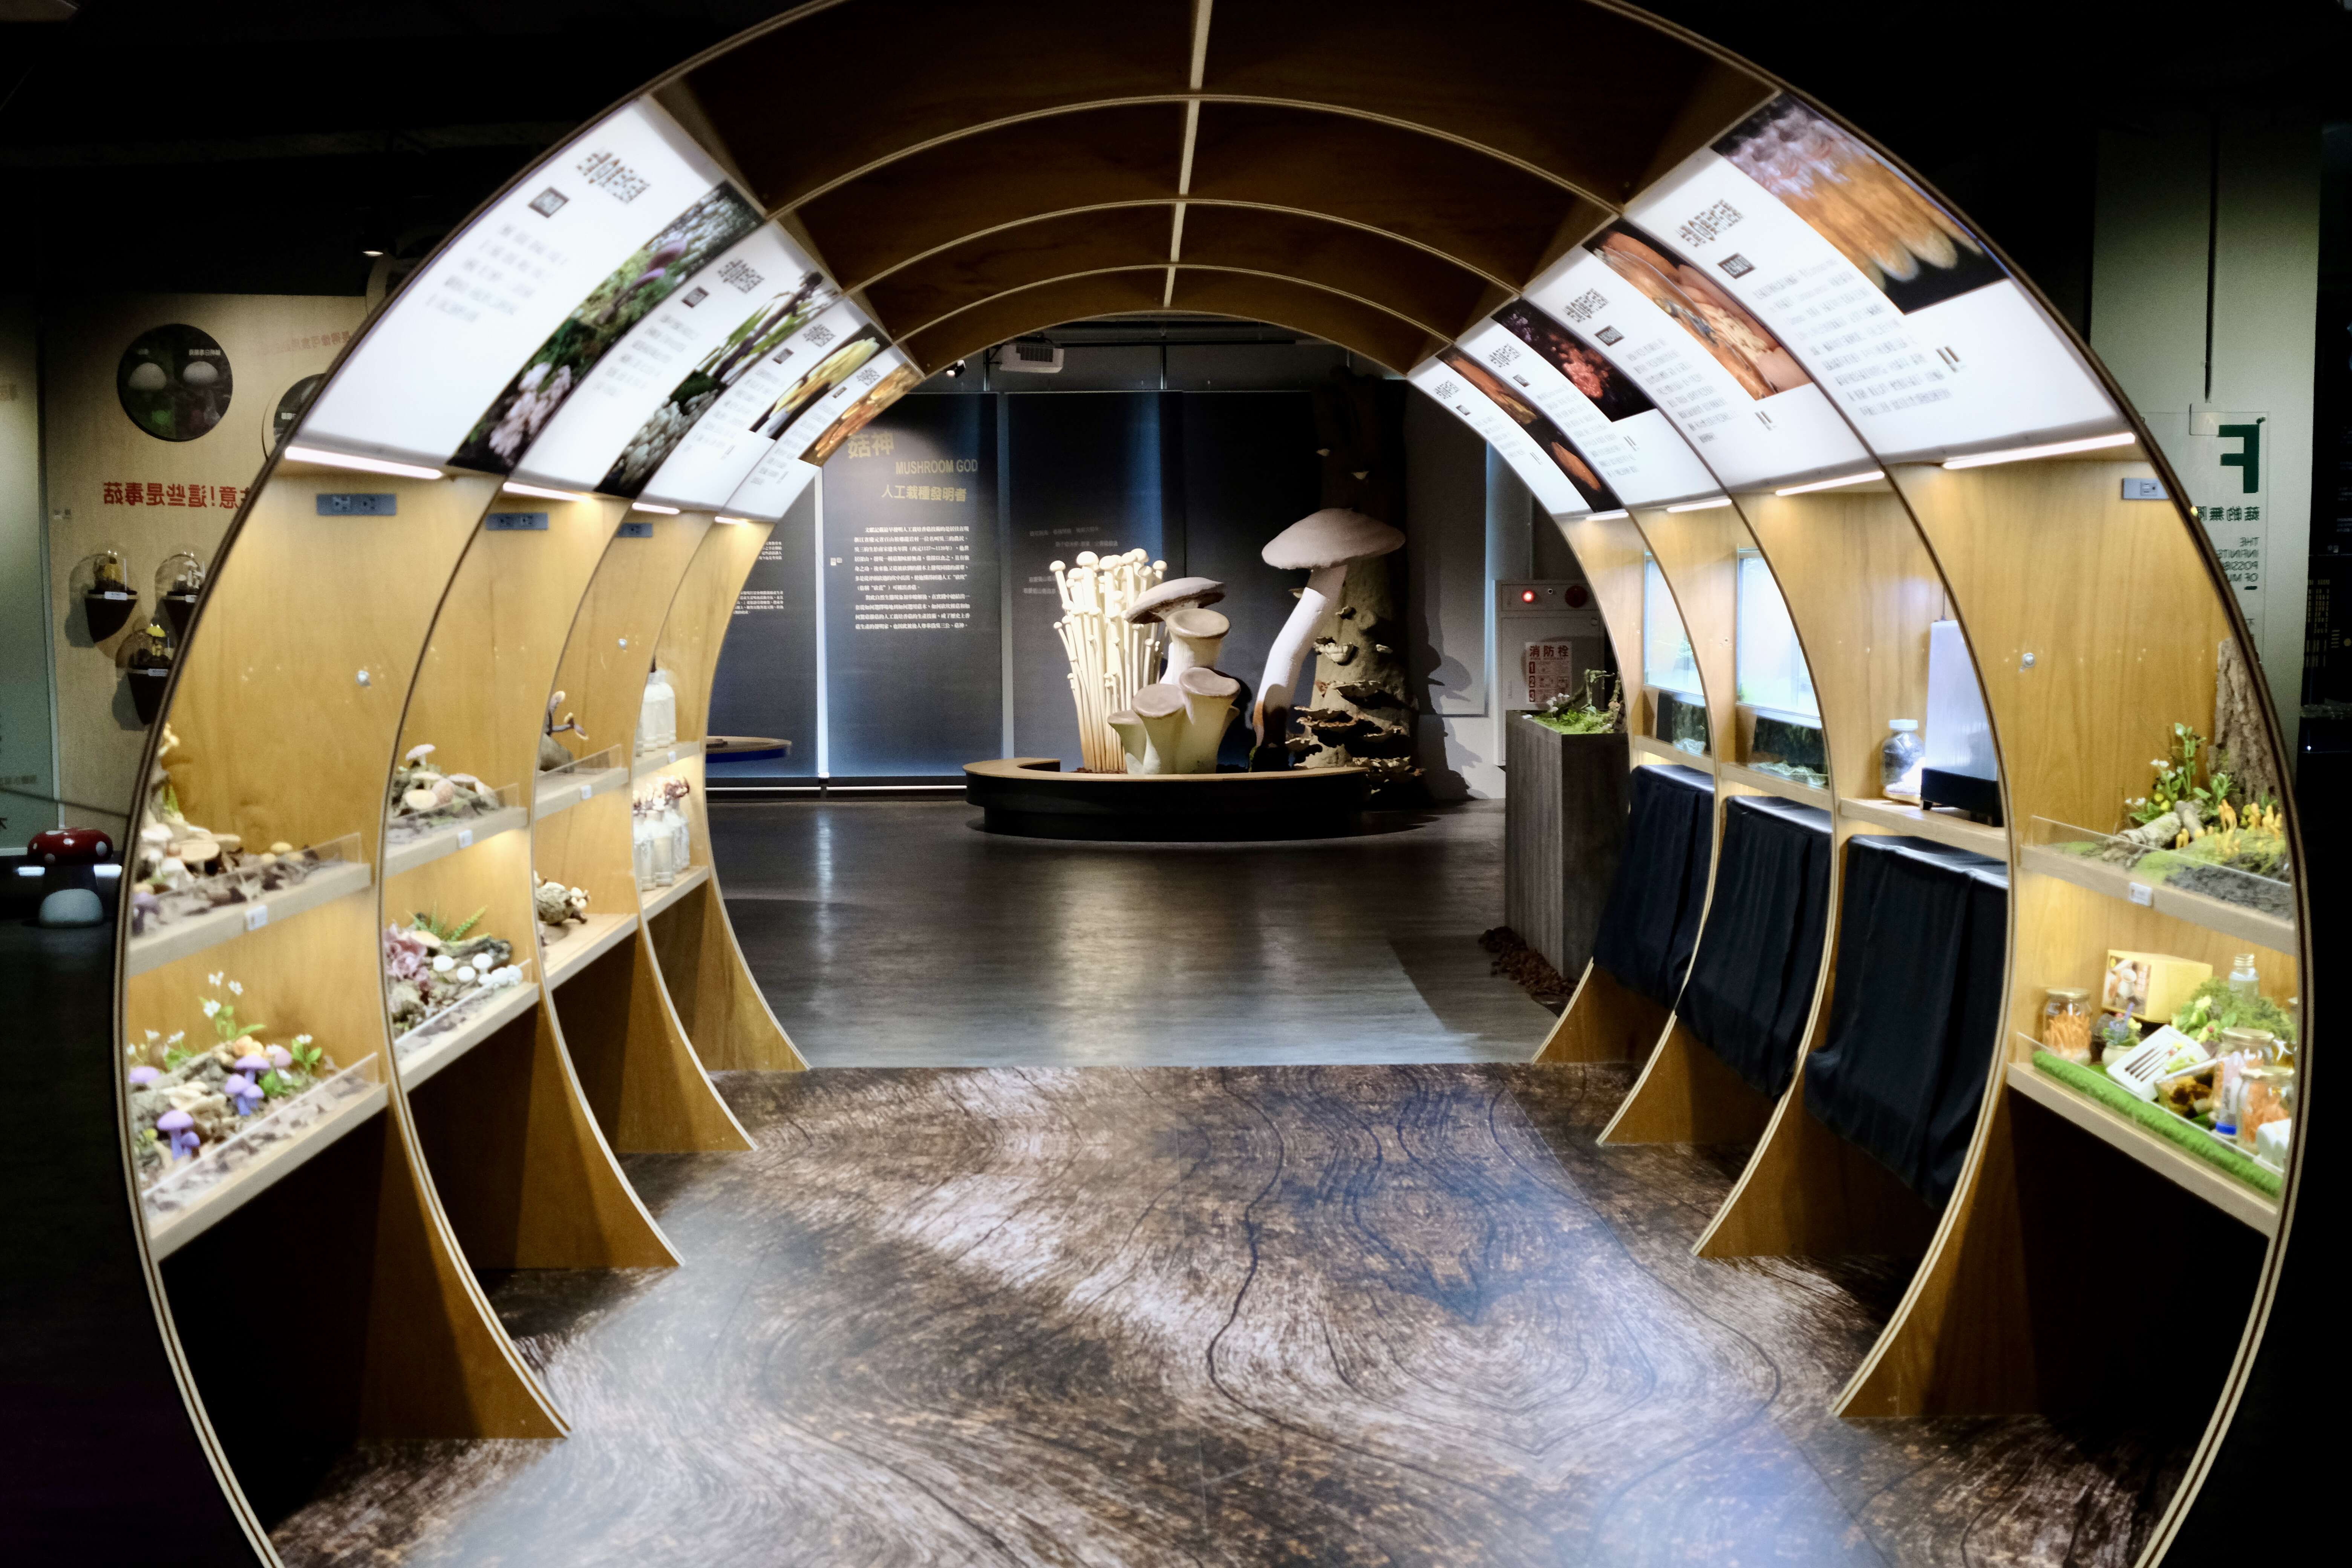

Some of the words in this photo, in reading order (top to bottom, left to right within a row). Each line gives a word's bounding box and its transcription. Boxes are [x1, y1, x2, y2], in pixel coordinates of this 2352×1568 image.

[847, 433, 895, 459] 菇神
[896, 460, 954, 475] MUSHROOM
[956, 459, 978, 472] GOD
[881, 484, 966, 502] 人工栽種發明者
[1530, 645, 1568, 657] 消防栓
